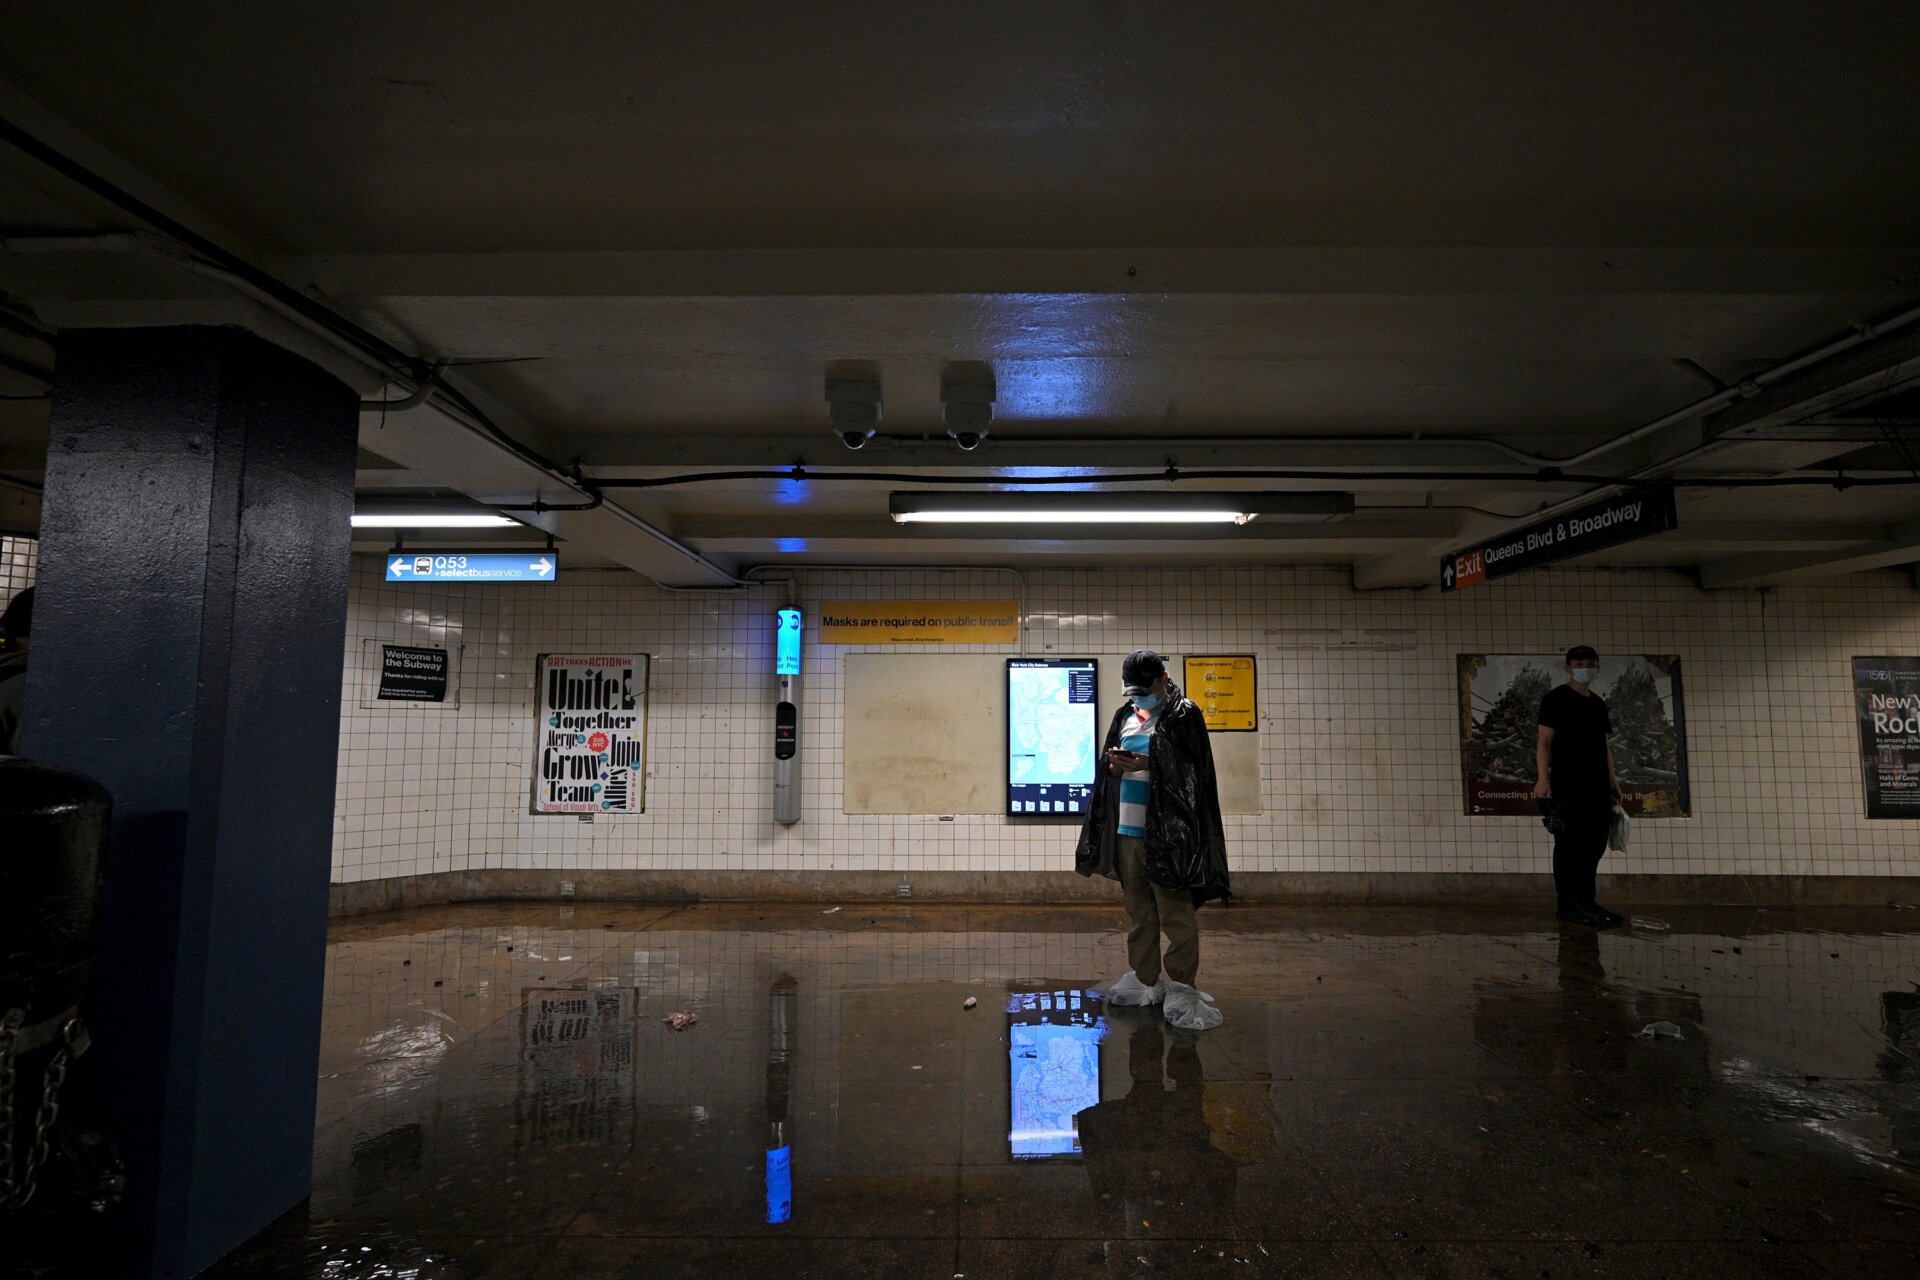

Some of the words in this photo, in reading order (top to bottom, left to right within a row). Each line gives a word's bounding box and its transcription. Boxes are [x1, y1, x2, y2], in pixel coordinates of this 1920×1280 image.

[1456, 553, 1481, 578] Exit
[1484, 541, 1524, 564] Queens
[1527, 528, 1553, 551] Blvd
[1556, 524, 1566, 542] &
[1570, 501, 1642, 538] Broadway
[434, 556, 468, 570] Q53
[822, 616, 858, 627] Masks
[860, 618, 878, 627] are
[880, 616, 926, 630] required
[928, 618, 942, 627] on
[944, 616, 976, 630] public
[979, 616, 1014, 627] transit
[386, 650, 432, 661] Welcome
[548, 657, 564, 666] ART
[589, 658, 621, 667] ACTION
[386, 658, 402, 667] the
[404, 660, 442, 672] Subway
[1872, 694, 1911, 709] New
[552, 712, 636, 732] Together
[547, 730, 578, 750] Merge
[606, 734, 640, 767] Join
[544, 748, 600, 780] Grow
[547, 781, 595, 802] Team
[604, 769, 627, 809] Allies
[1478, 790, 1528, 801] Connecting
[543, 803, 561, 811] School
[562, 803, 569, 811] of
[570, 803, 586, 811] Visual
[587, 803, 599, 811] Arts
